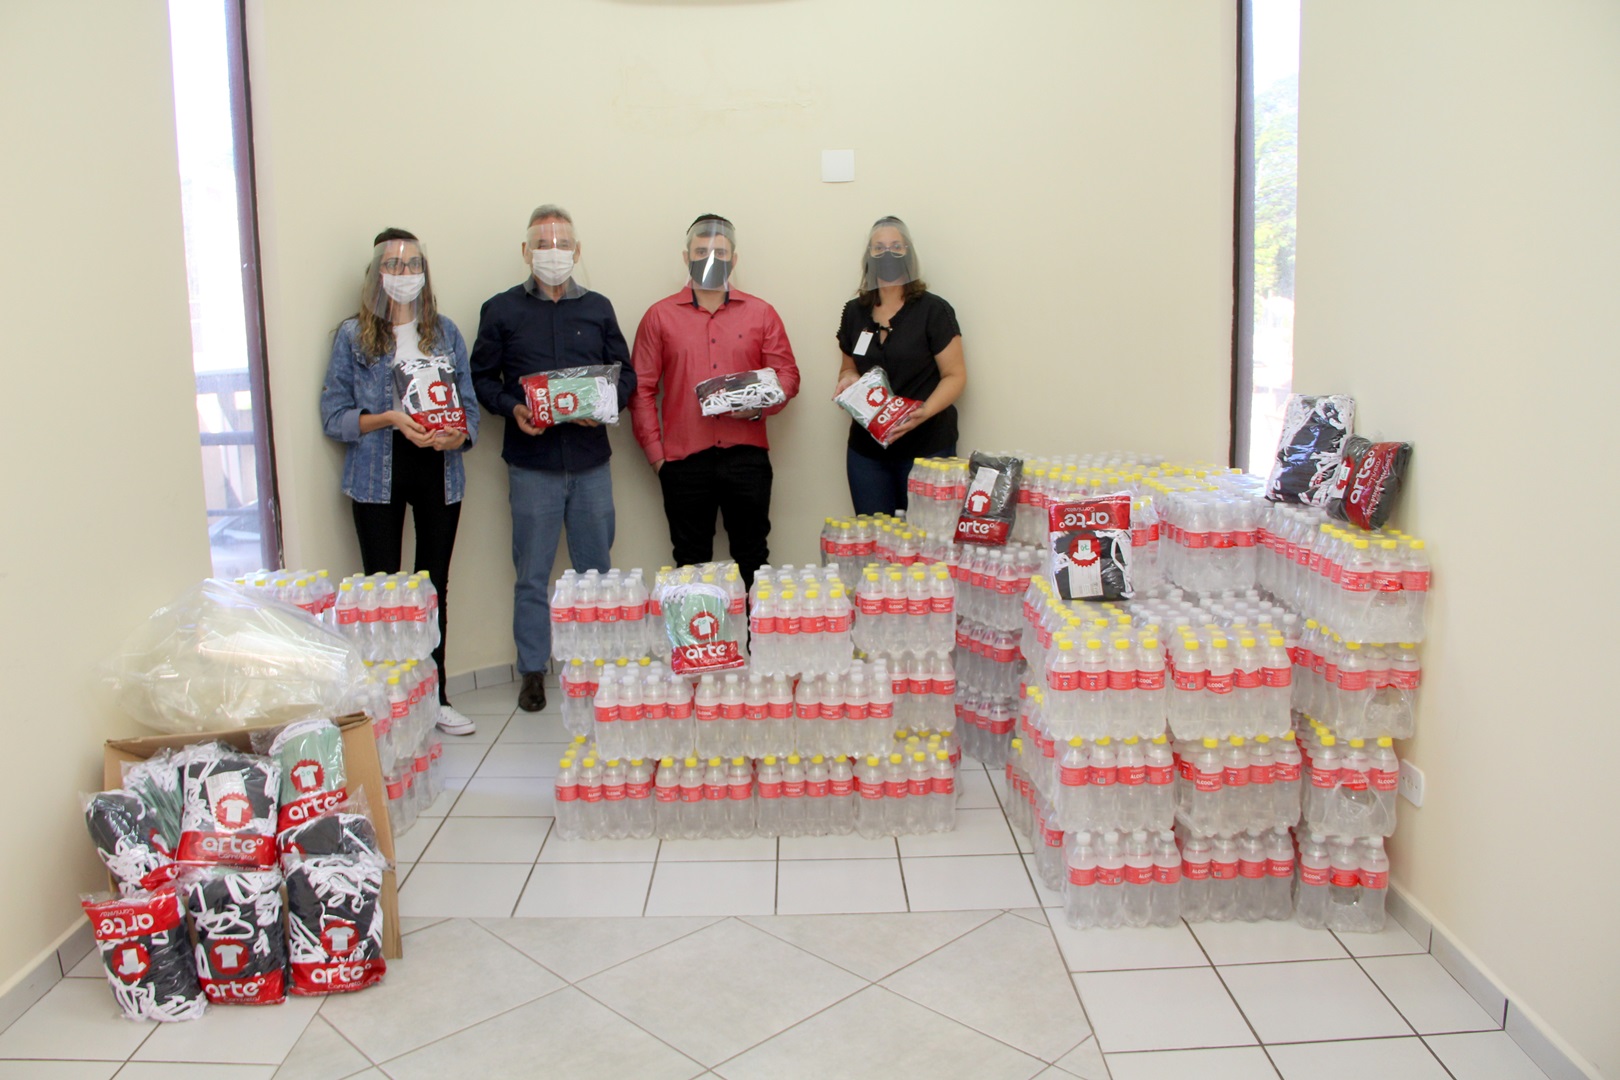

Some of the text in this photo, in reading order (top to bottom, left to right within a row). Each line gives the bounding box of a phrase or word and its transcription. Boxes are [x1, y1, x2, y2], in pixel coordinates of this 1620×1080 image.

[536, 388, 550, 421] arte
[877, 397, 905, 424] arte
[427, 410, 461, 424] arte
[1350, 456, 1376, 504] arte
[958, 520, 990, 534] arte
[1064, 512, 1110, 528] arte
[685, 643, 727, 660] arte
[289, 796, 339, 820] arte
[202, 835, 257, 854] arte
[100, 913, 154, 936] arte
[311, 963, 364, 984] arte
[205, 980, 259, 998] arte
